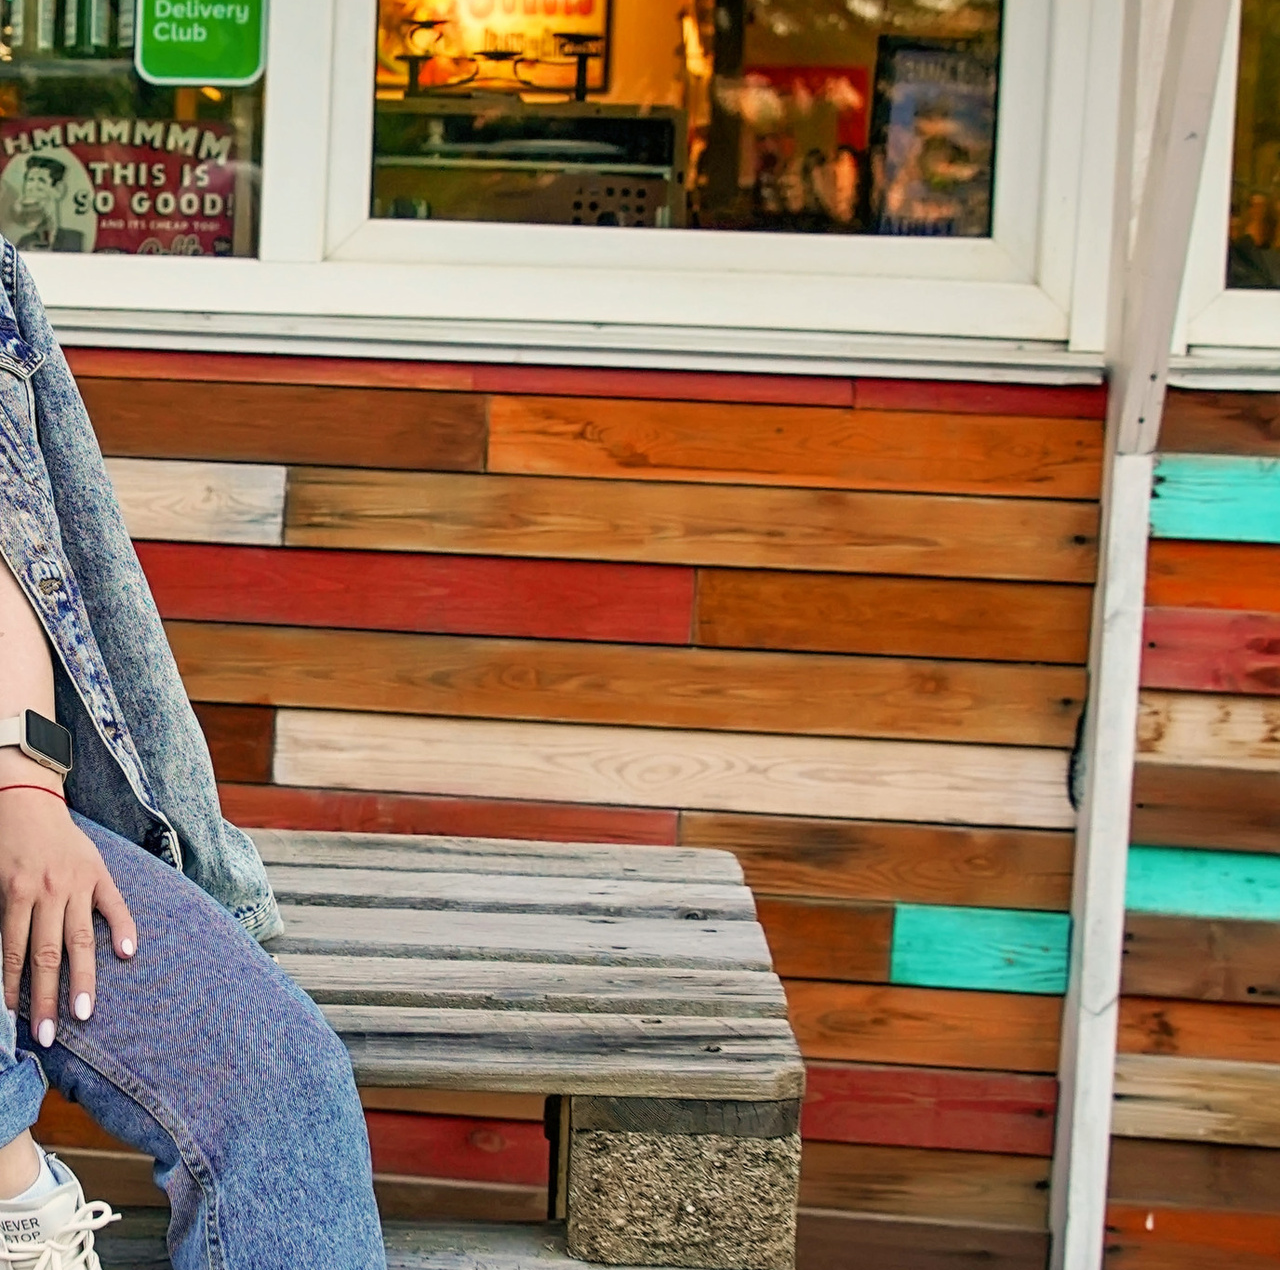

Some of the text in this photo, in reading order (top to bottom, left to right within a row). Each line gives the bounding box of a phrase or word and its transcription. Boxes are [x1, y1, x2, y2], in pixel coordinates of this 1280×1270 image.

[153, 21, 208, 42] Club
[88, 161, 209, 188] THIS IS
[74, 190, 233, 217] SO GOOD!
